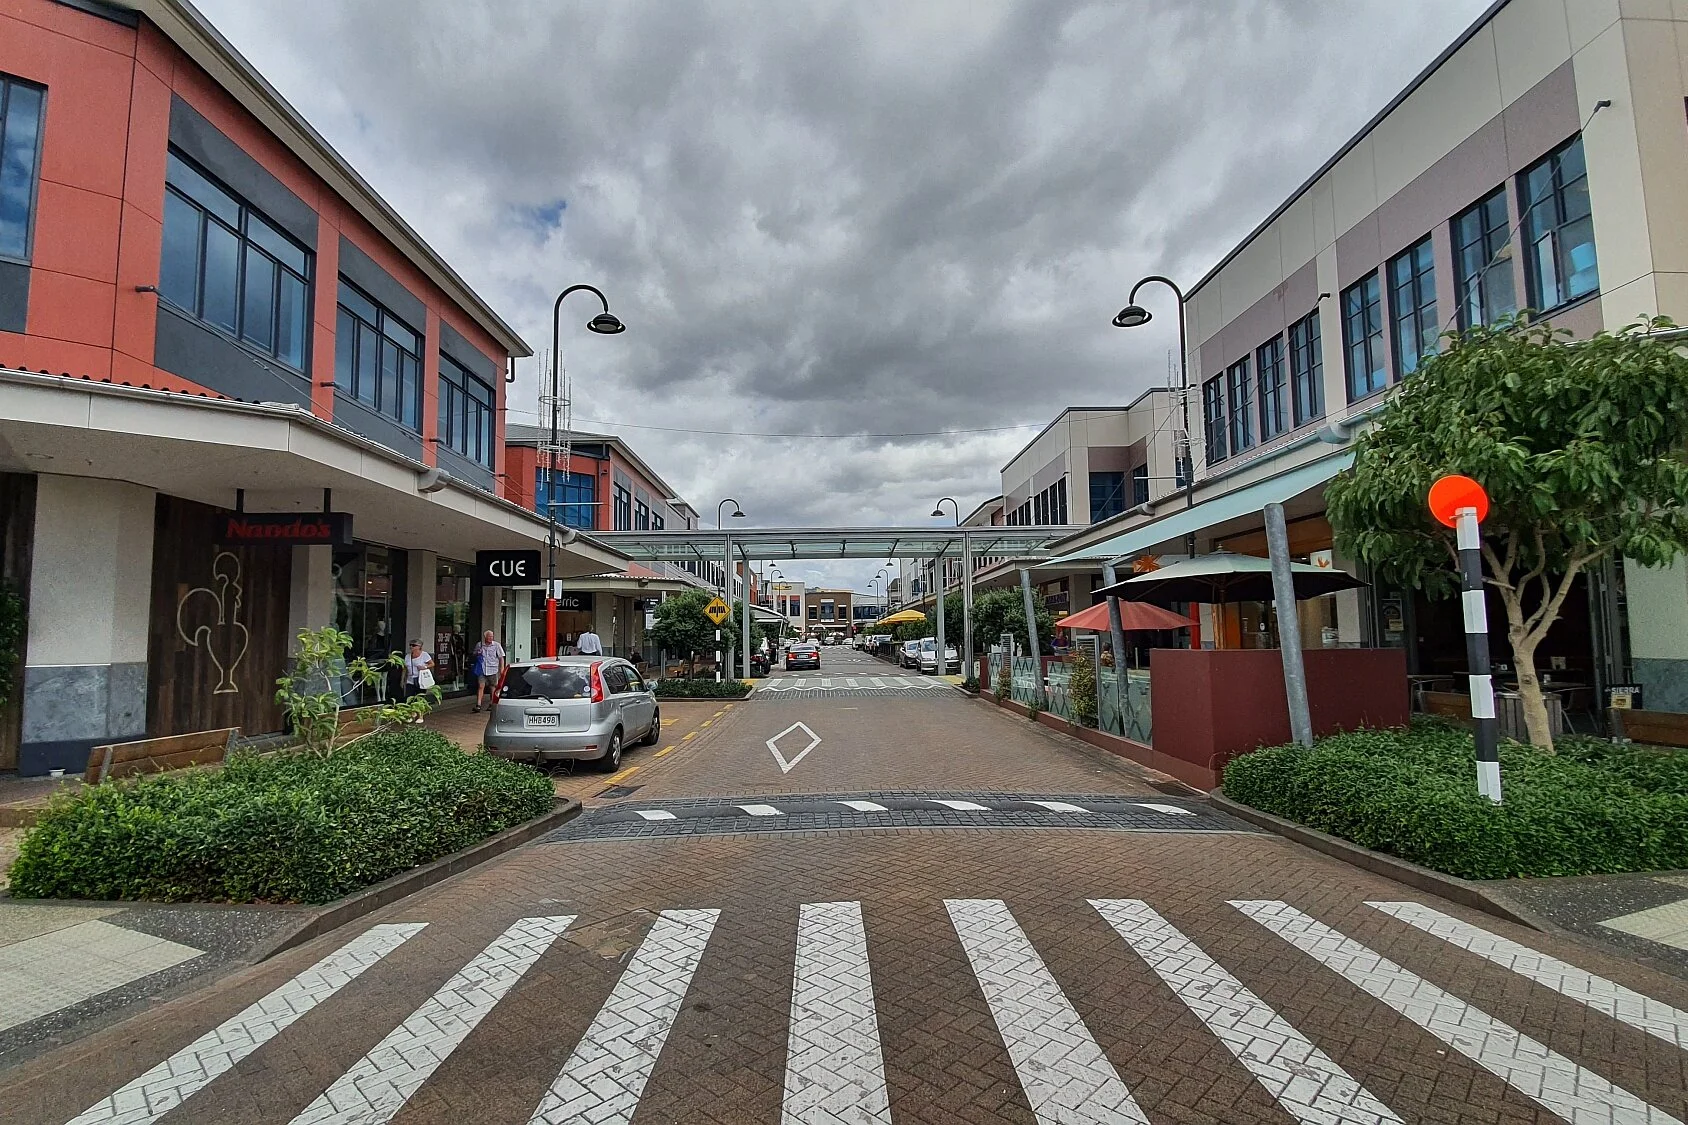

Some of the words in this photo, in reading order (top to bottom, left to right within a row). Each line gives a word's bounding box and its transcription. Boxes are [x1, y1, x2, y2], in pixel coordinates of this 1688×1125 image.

[225, 518, 331, 538] Nando's
[489, 560, 526, 577] CUE
[1611, 686, 1641, 694] SIERRA
